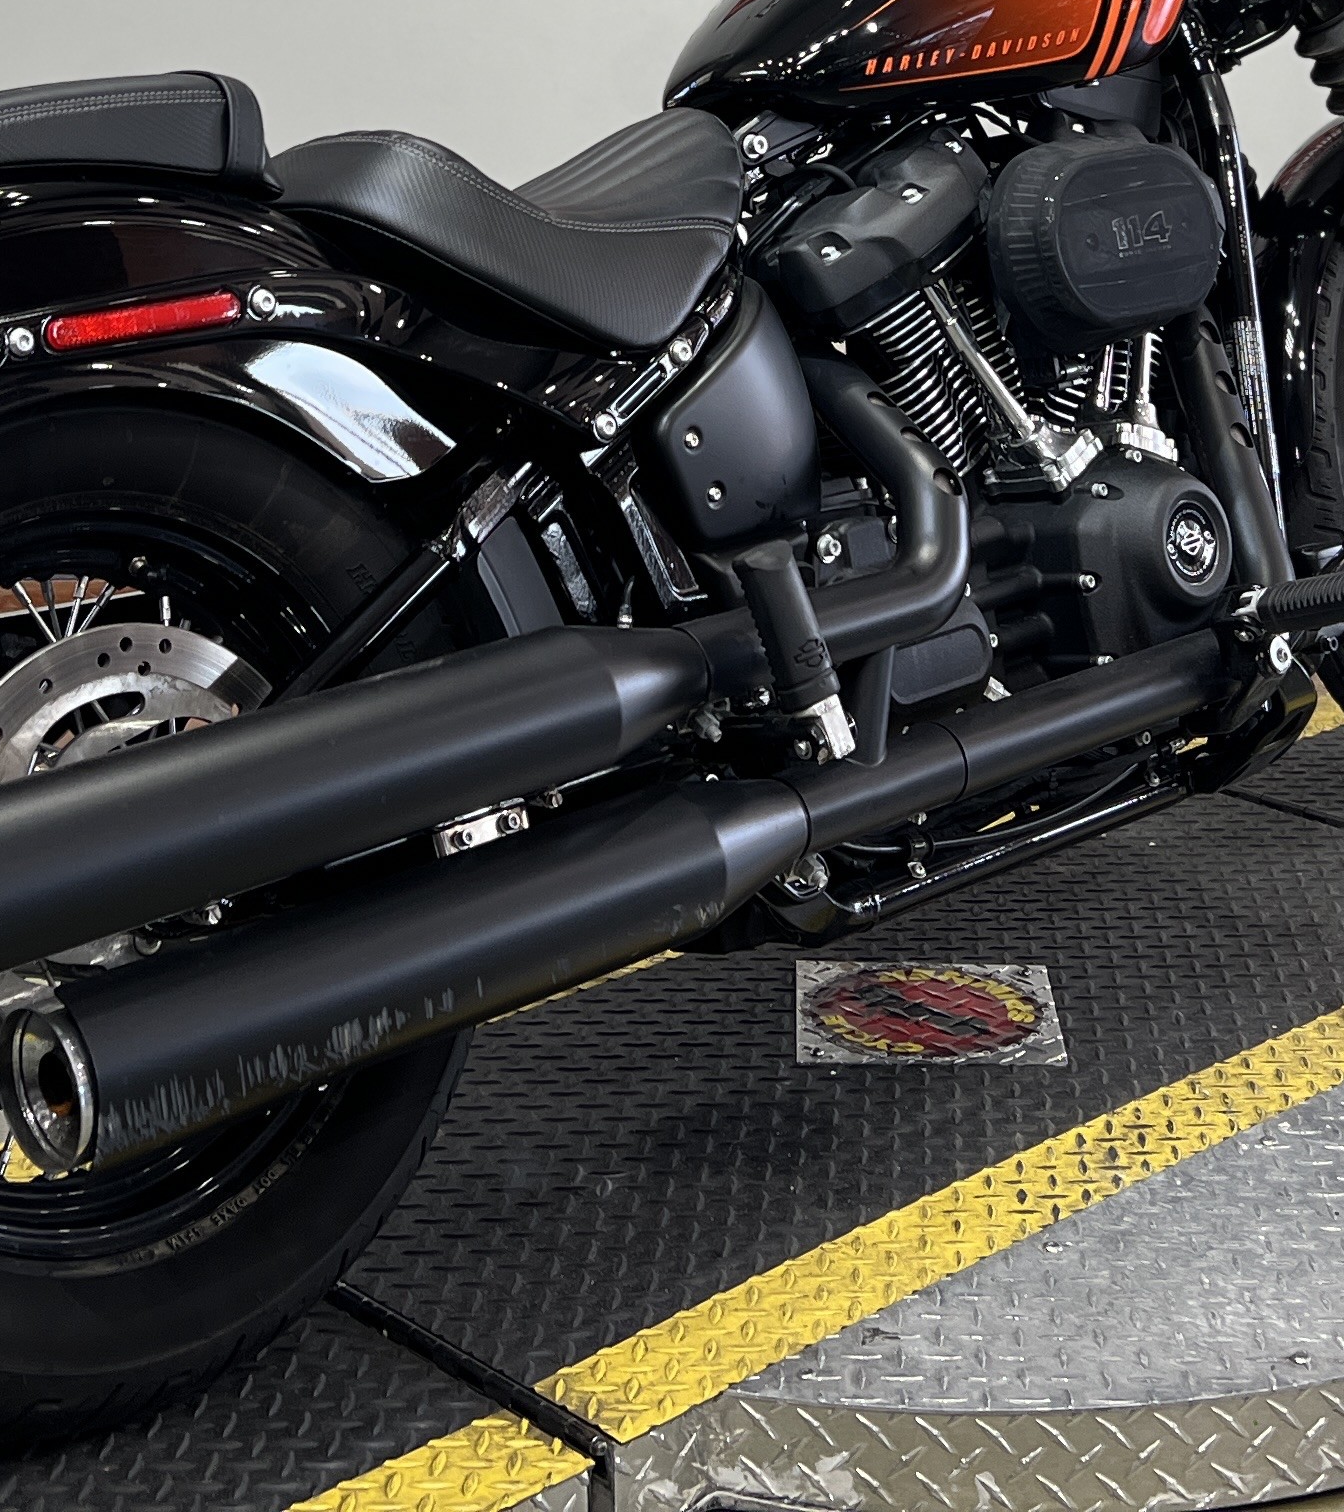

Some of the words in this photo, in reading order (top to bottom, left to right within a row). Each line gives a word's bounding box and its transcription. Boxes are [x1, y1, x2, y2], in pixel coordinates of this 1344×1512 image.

[865, 27, 1081, 76] HARLEY-DAVIDSON
[1111, 210, 1172, 250] 114
[254, 1170, 281, 1195] DOT
